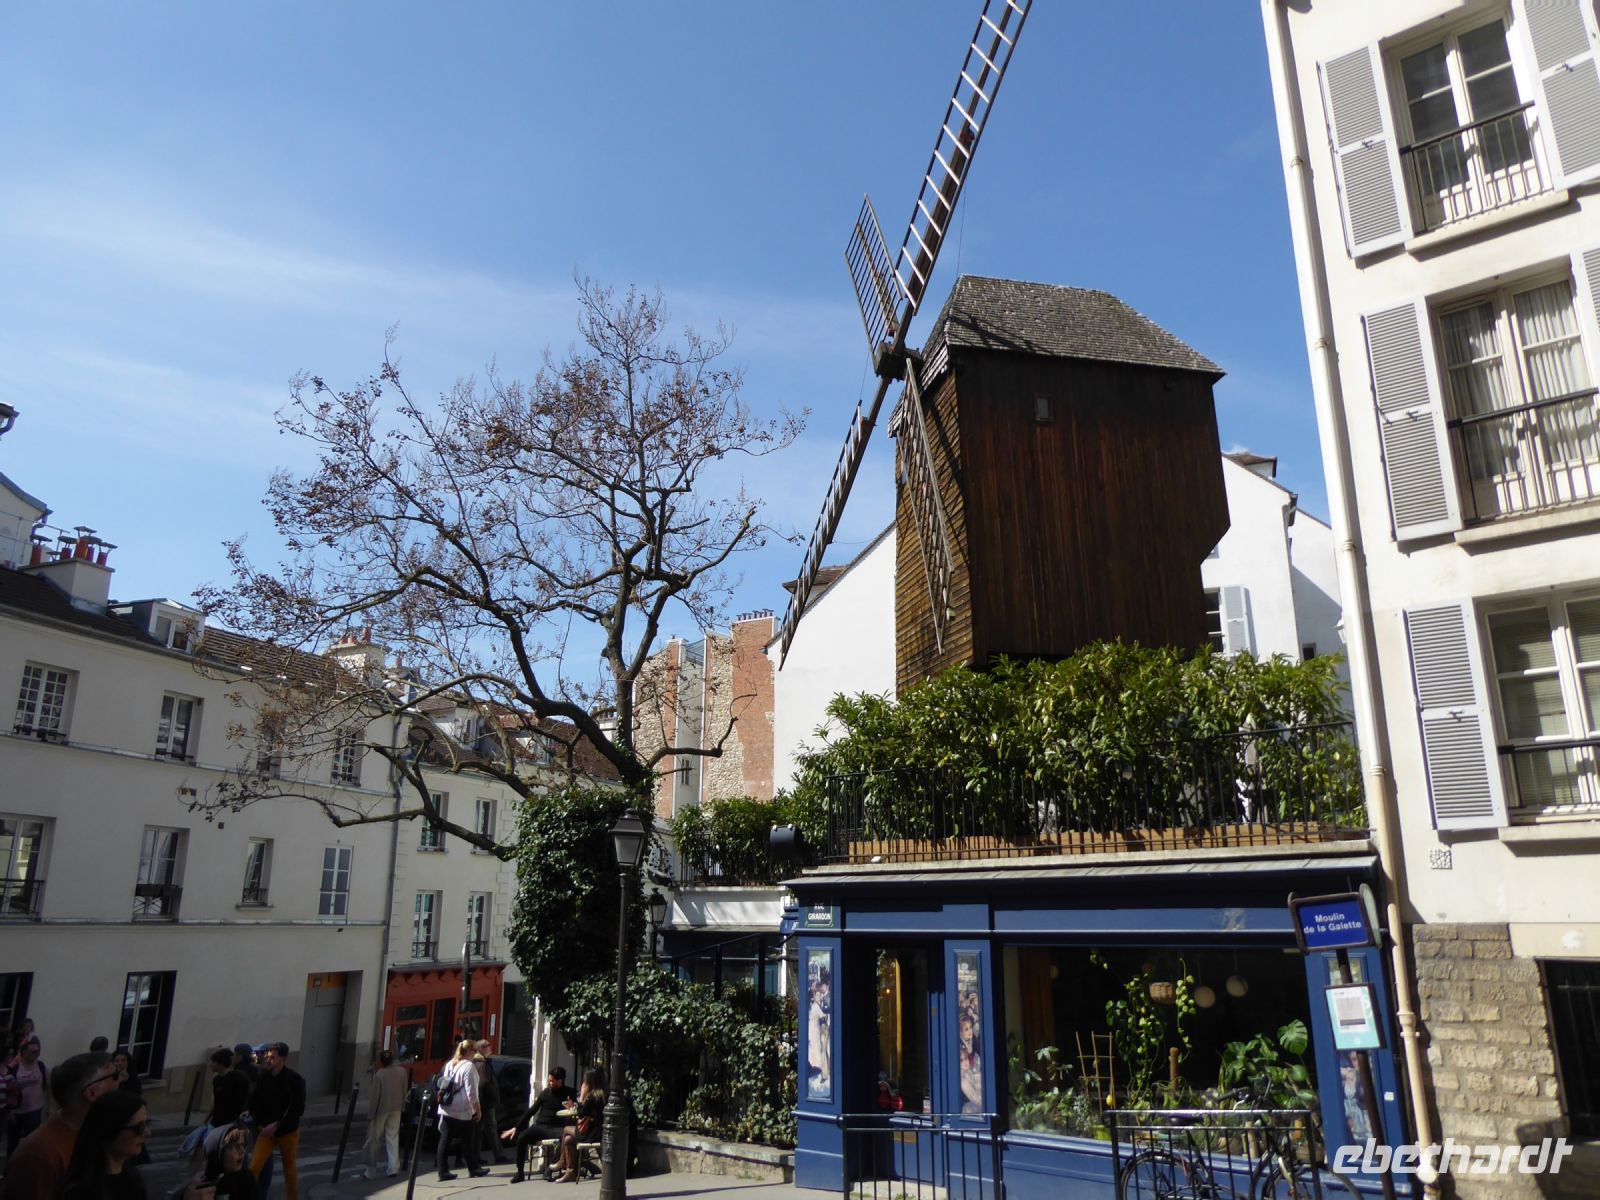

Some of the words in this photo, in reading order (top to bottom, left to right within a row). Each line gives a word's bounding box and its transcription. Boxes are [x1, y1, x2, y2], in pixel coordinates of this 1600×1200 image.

[1315, 913, 1345, 923] Moulin
[1303, 926, 1315, 934] de
[1317, 924, 1326, 932] la
[1328, 921, 1362, 931] Galette
